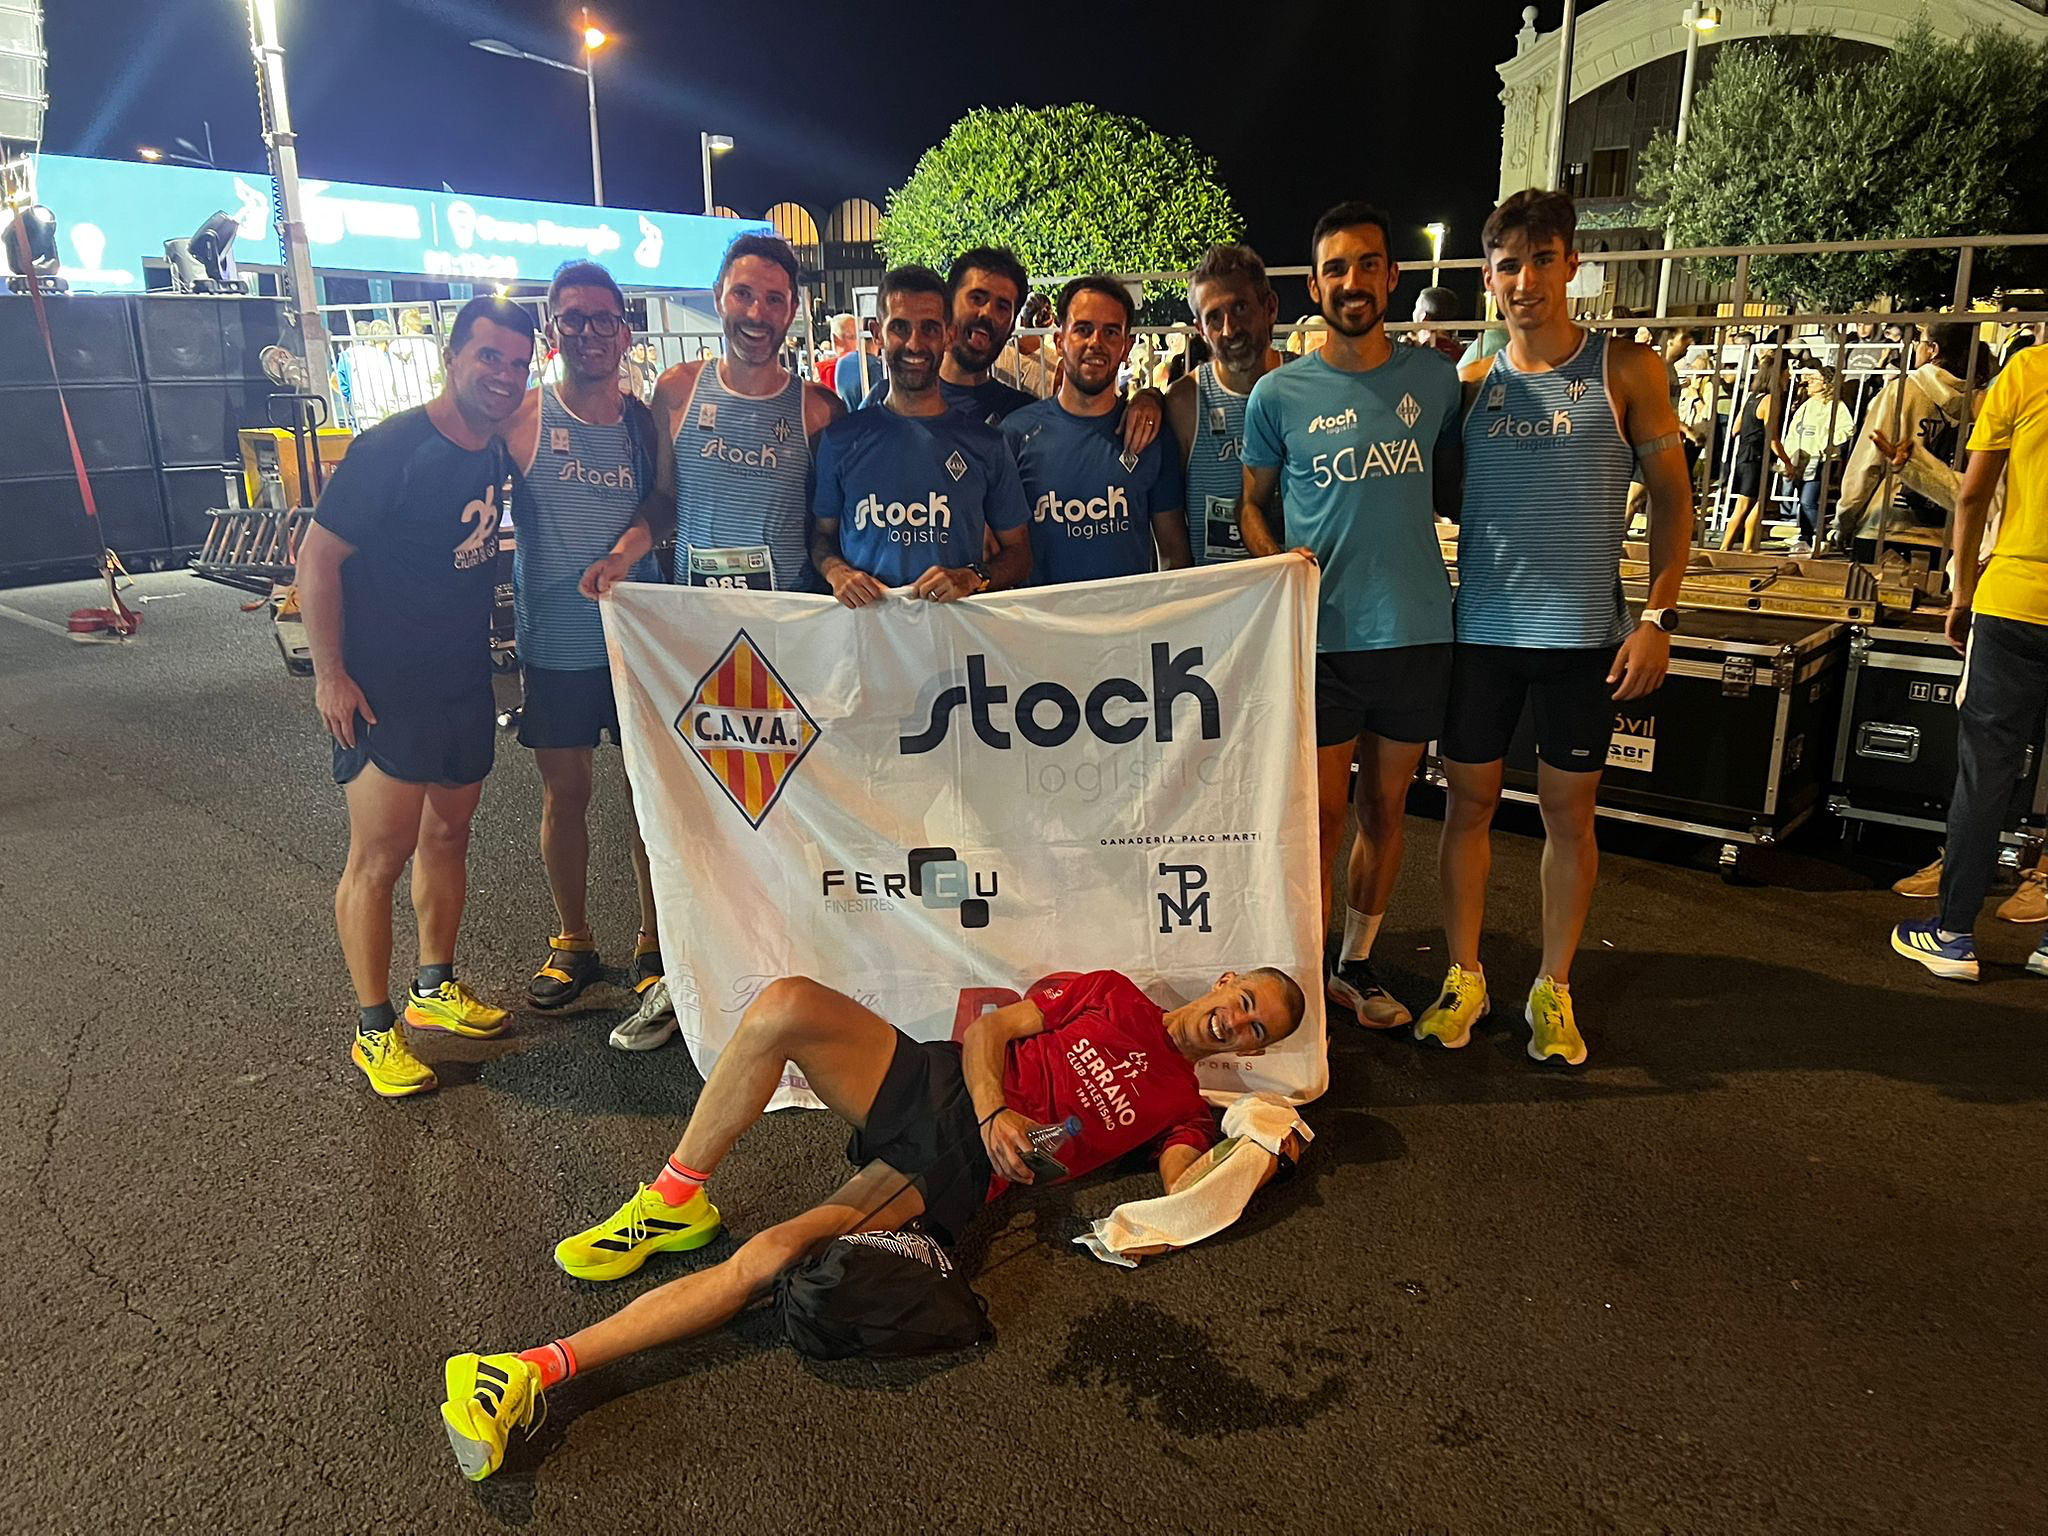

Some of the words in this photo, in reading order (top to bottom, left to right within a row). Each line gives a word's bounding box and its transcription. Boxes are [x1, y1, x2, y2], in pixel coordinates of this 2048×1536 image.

[1308, 408, 1357, 433] stock
[1487, 409, 1573, 438] stock
[700, 437, 777, 468] stock
[559, 458, 634, 489] stock
[854, 491, 951, 531] stock
[1034, 485, 1129, 523] stock
[887, 527, 949, 546] logistic
[1067, 519, 1129, 539] logistic
[705, 576, 748, 589] 985
[899, 642, 1221, 755] stock
[694, 711, 798, 746] C.A.V.A.
[1025, 748, 1226, 802] logistic
[1182, 834, 1215, 843] PACO
[822, 869, 998, 899] FERCU
[825, 899, 895, 913] FINESTRES
[1066, 1051, 1087, 1077] CLUB
[1082, 1078, 1115, 1130] ATLETISMO
[1072, 1038, 1136, 1126] SERRANO
